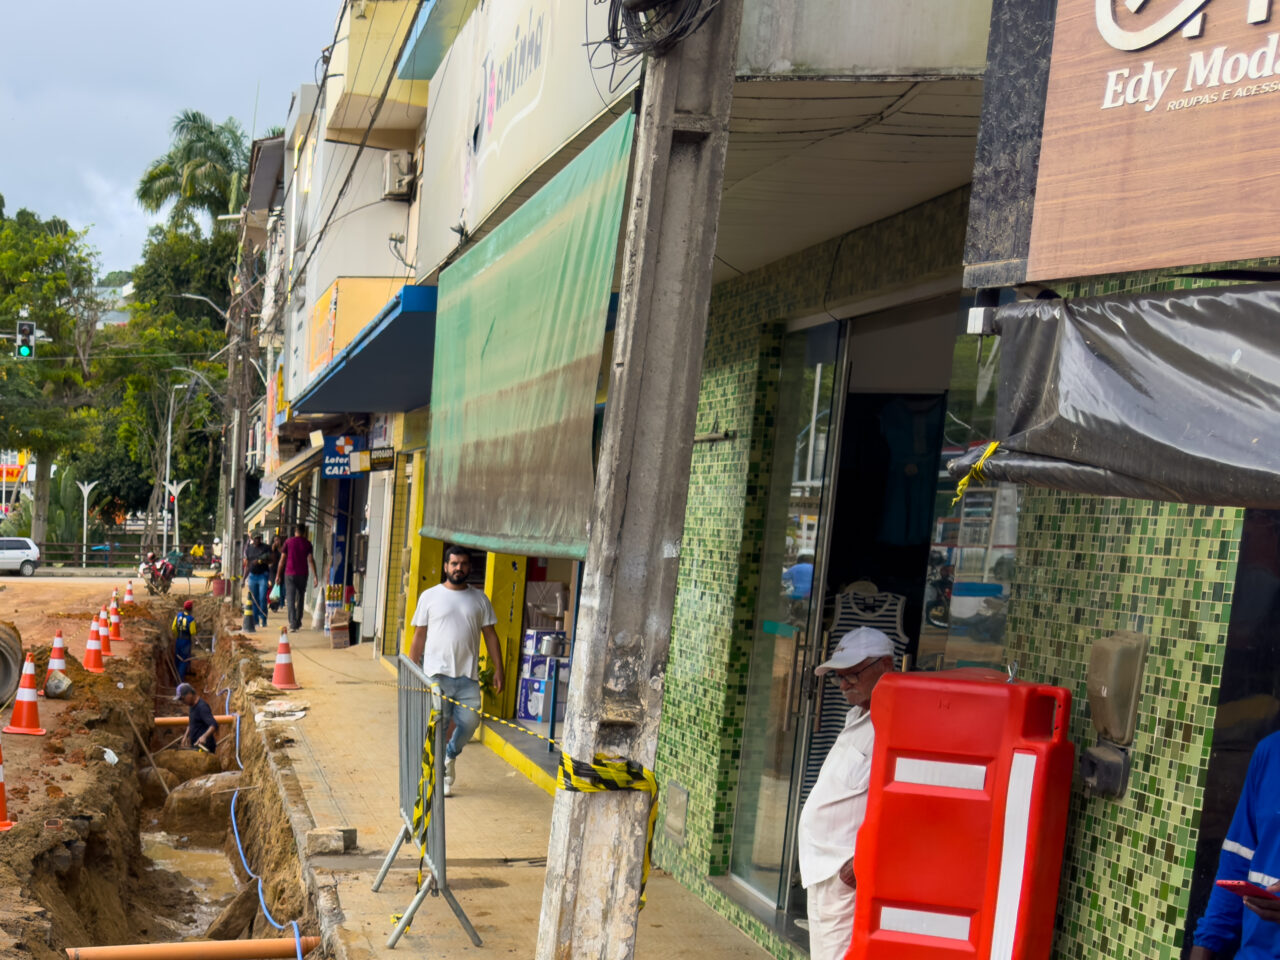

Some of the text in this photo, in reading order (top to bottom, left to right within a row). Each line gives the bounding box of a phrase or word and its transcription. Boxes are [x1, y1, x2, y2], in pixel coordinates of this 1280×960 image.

[1101, 61, 1178, 112] Edy
[1167, 93, 1219, 111] ROUPAS
[1221, 90, 1232, 100] E
[324, 456, 349, 464] Loter
[325, 466, 350, 475] CAIX
